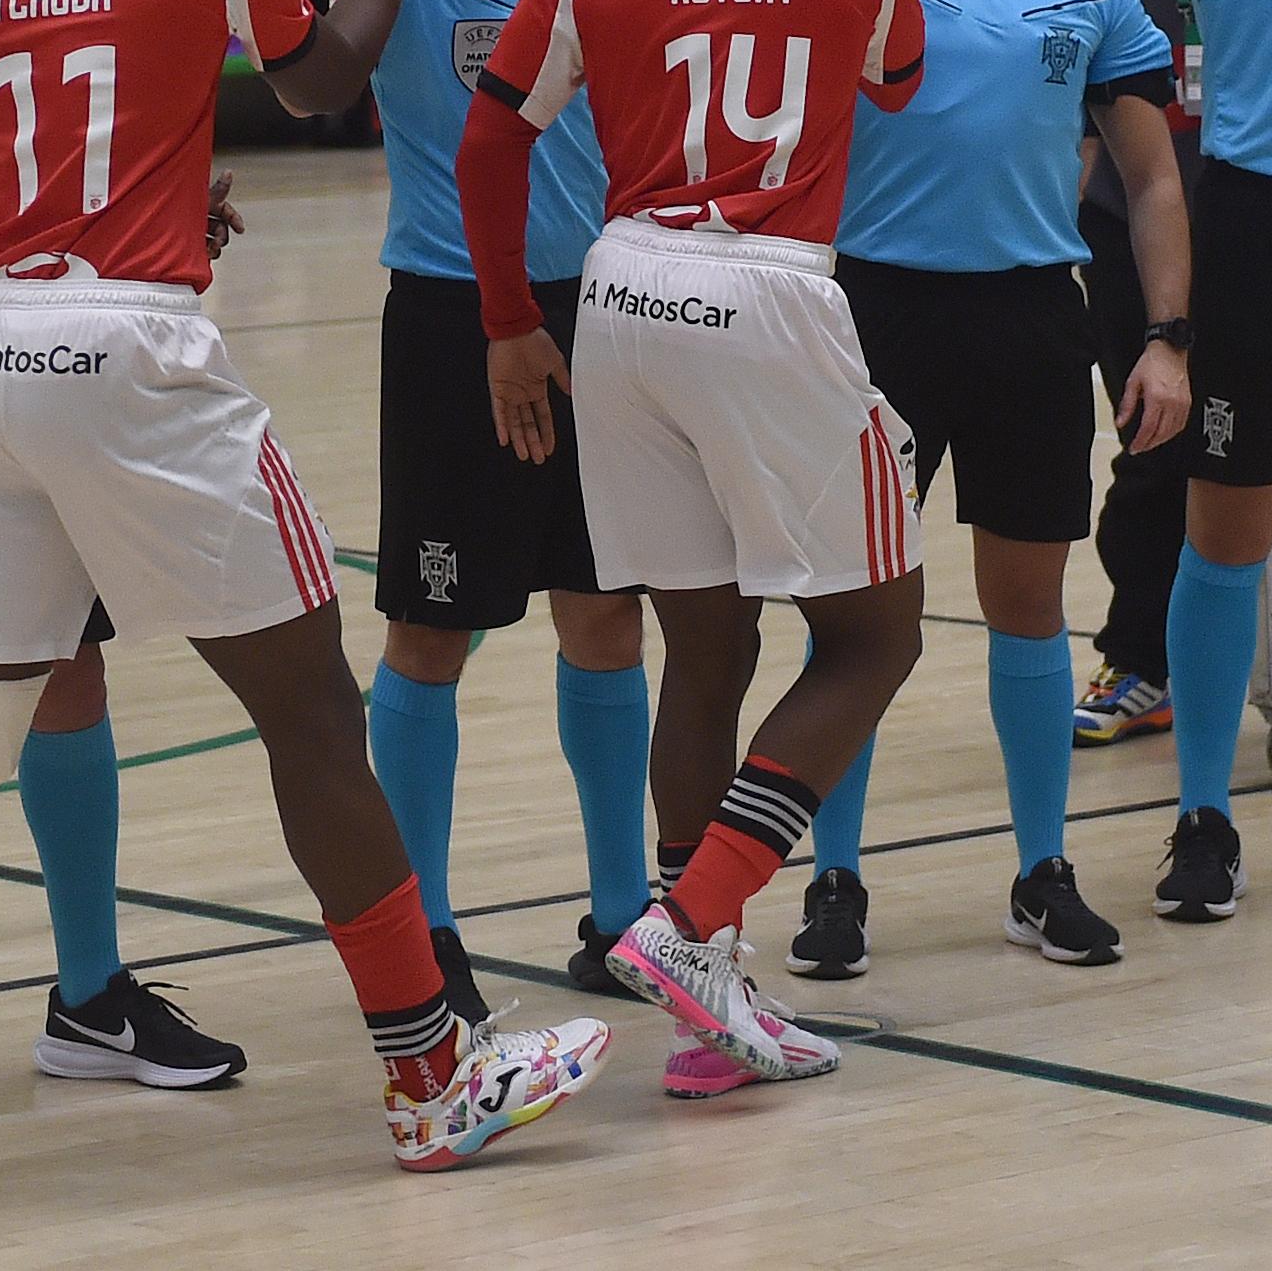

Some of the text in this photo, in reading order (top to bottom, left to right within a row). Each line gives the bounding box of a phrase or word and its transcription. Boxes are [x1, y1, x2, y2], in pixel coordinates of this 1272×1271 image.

[465, 52, 492, 62] MAT
[664, 32, 812, 191] 14
[582, 278, 738, 330] A MatosCar
